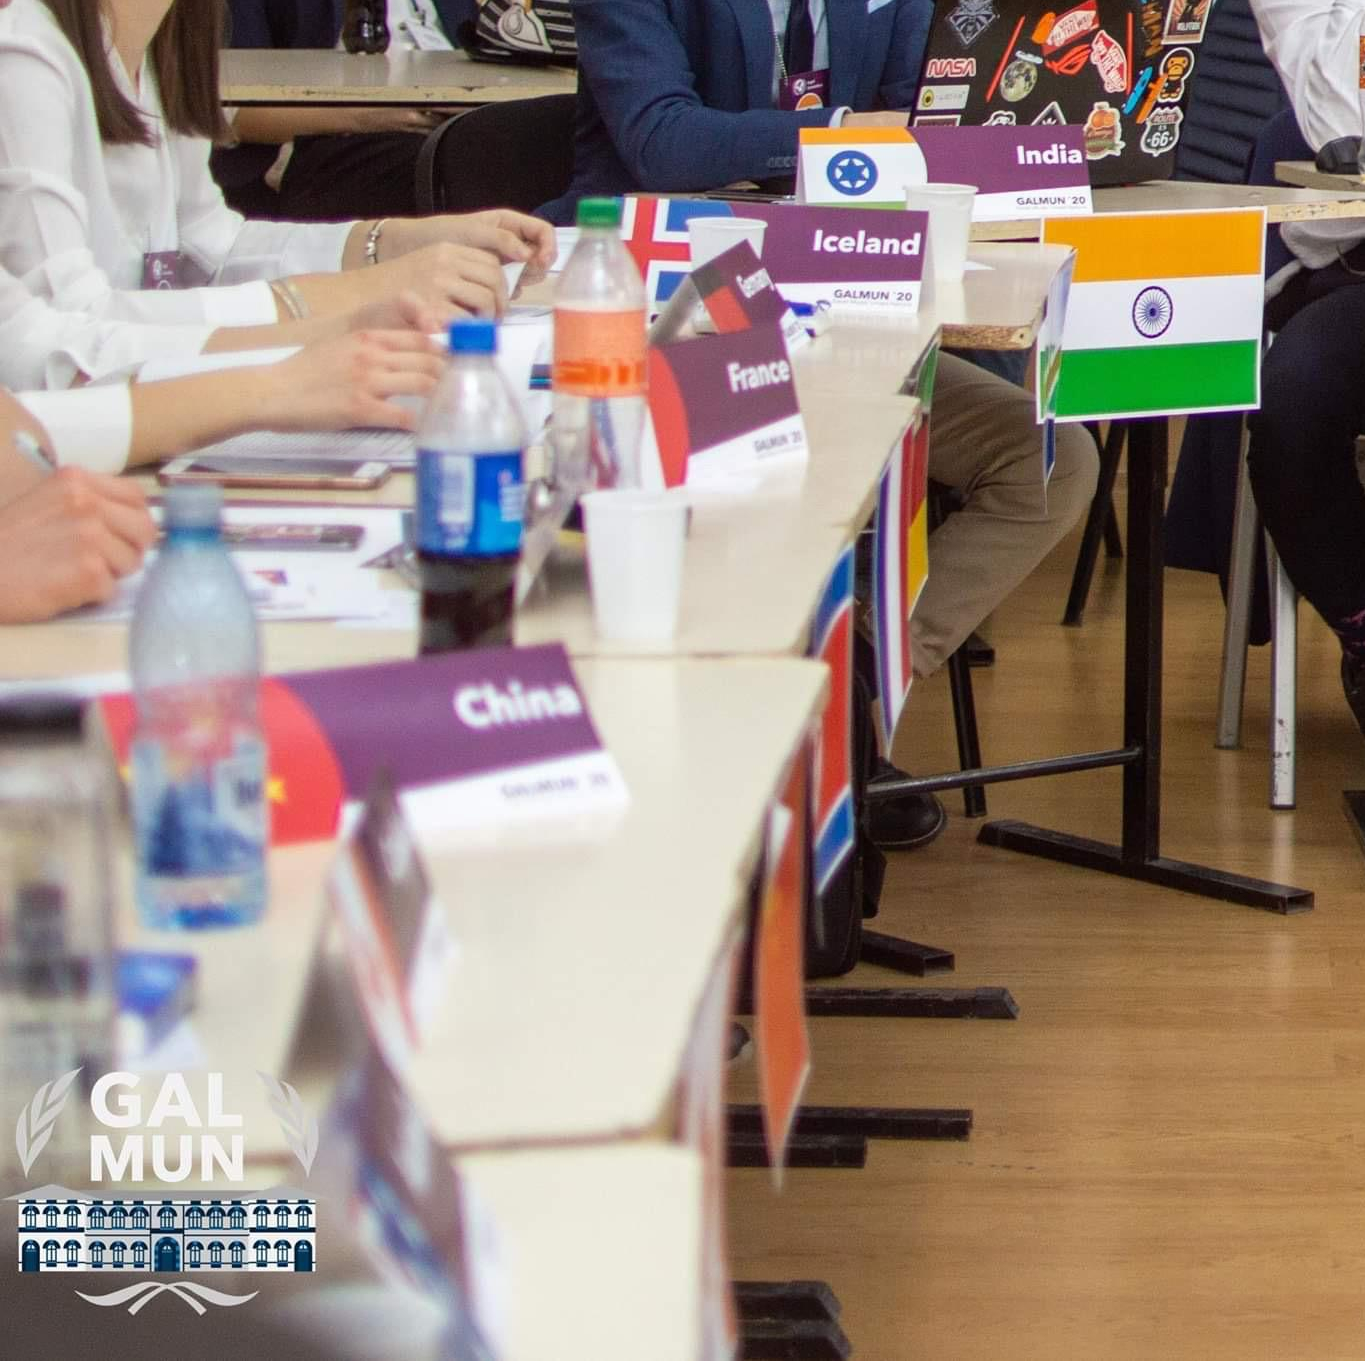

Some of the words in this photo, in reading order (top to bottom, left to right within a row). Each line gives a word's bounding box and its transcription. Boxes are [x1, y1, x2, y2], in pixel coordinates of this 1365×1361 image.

[926, 58, 976, 78] NASA
[1151, 132, 1169, 148] 66
[1016, 143, 1083, 165] India
[1016, 196, 1066, 206] GALMUN
[813, 229, 921, 255] Iceland
[834, 289, 890, 301] GALMUN
[727, 359, 790, 393] France
[454, 679, 582, 729] China
